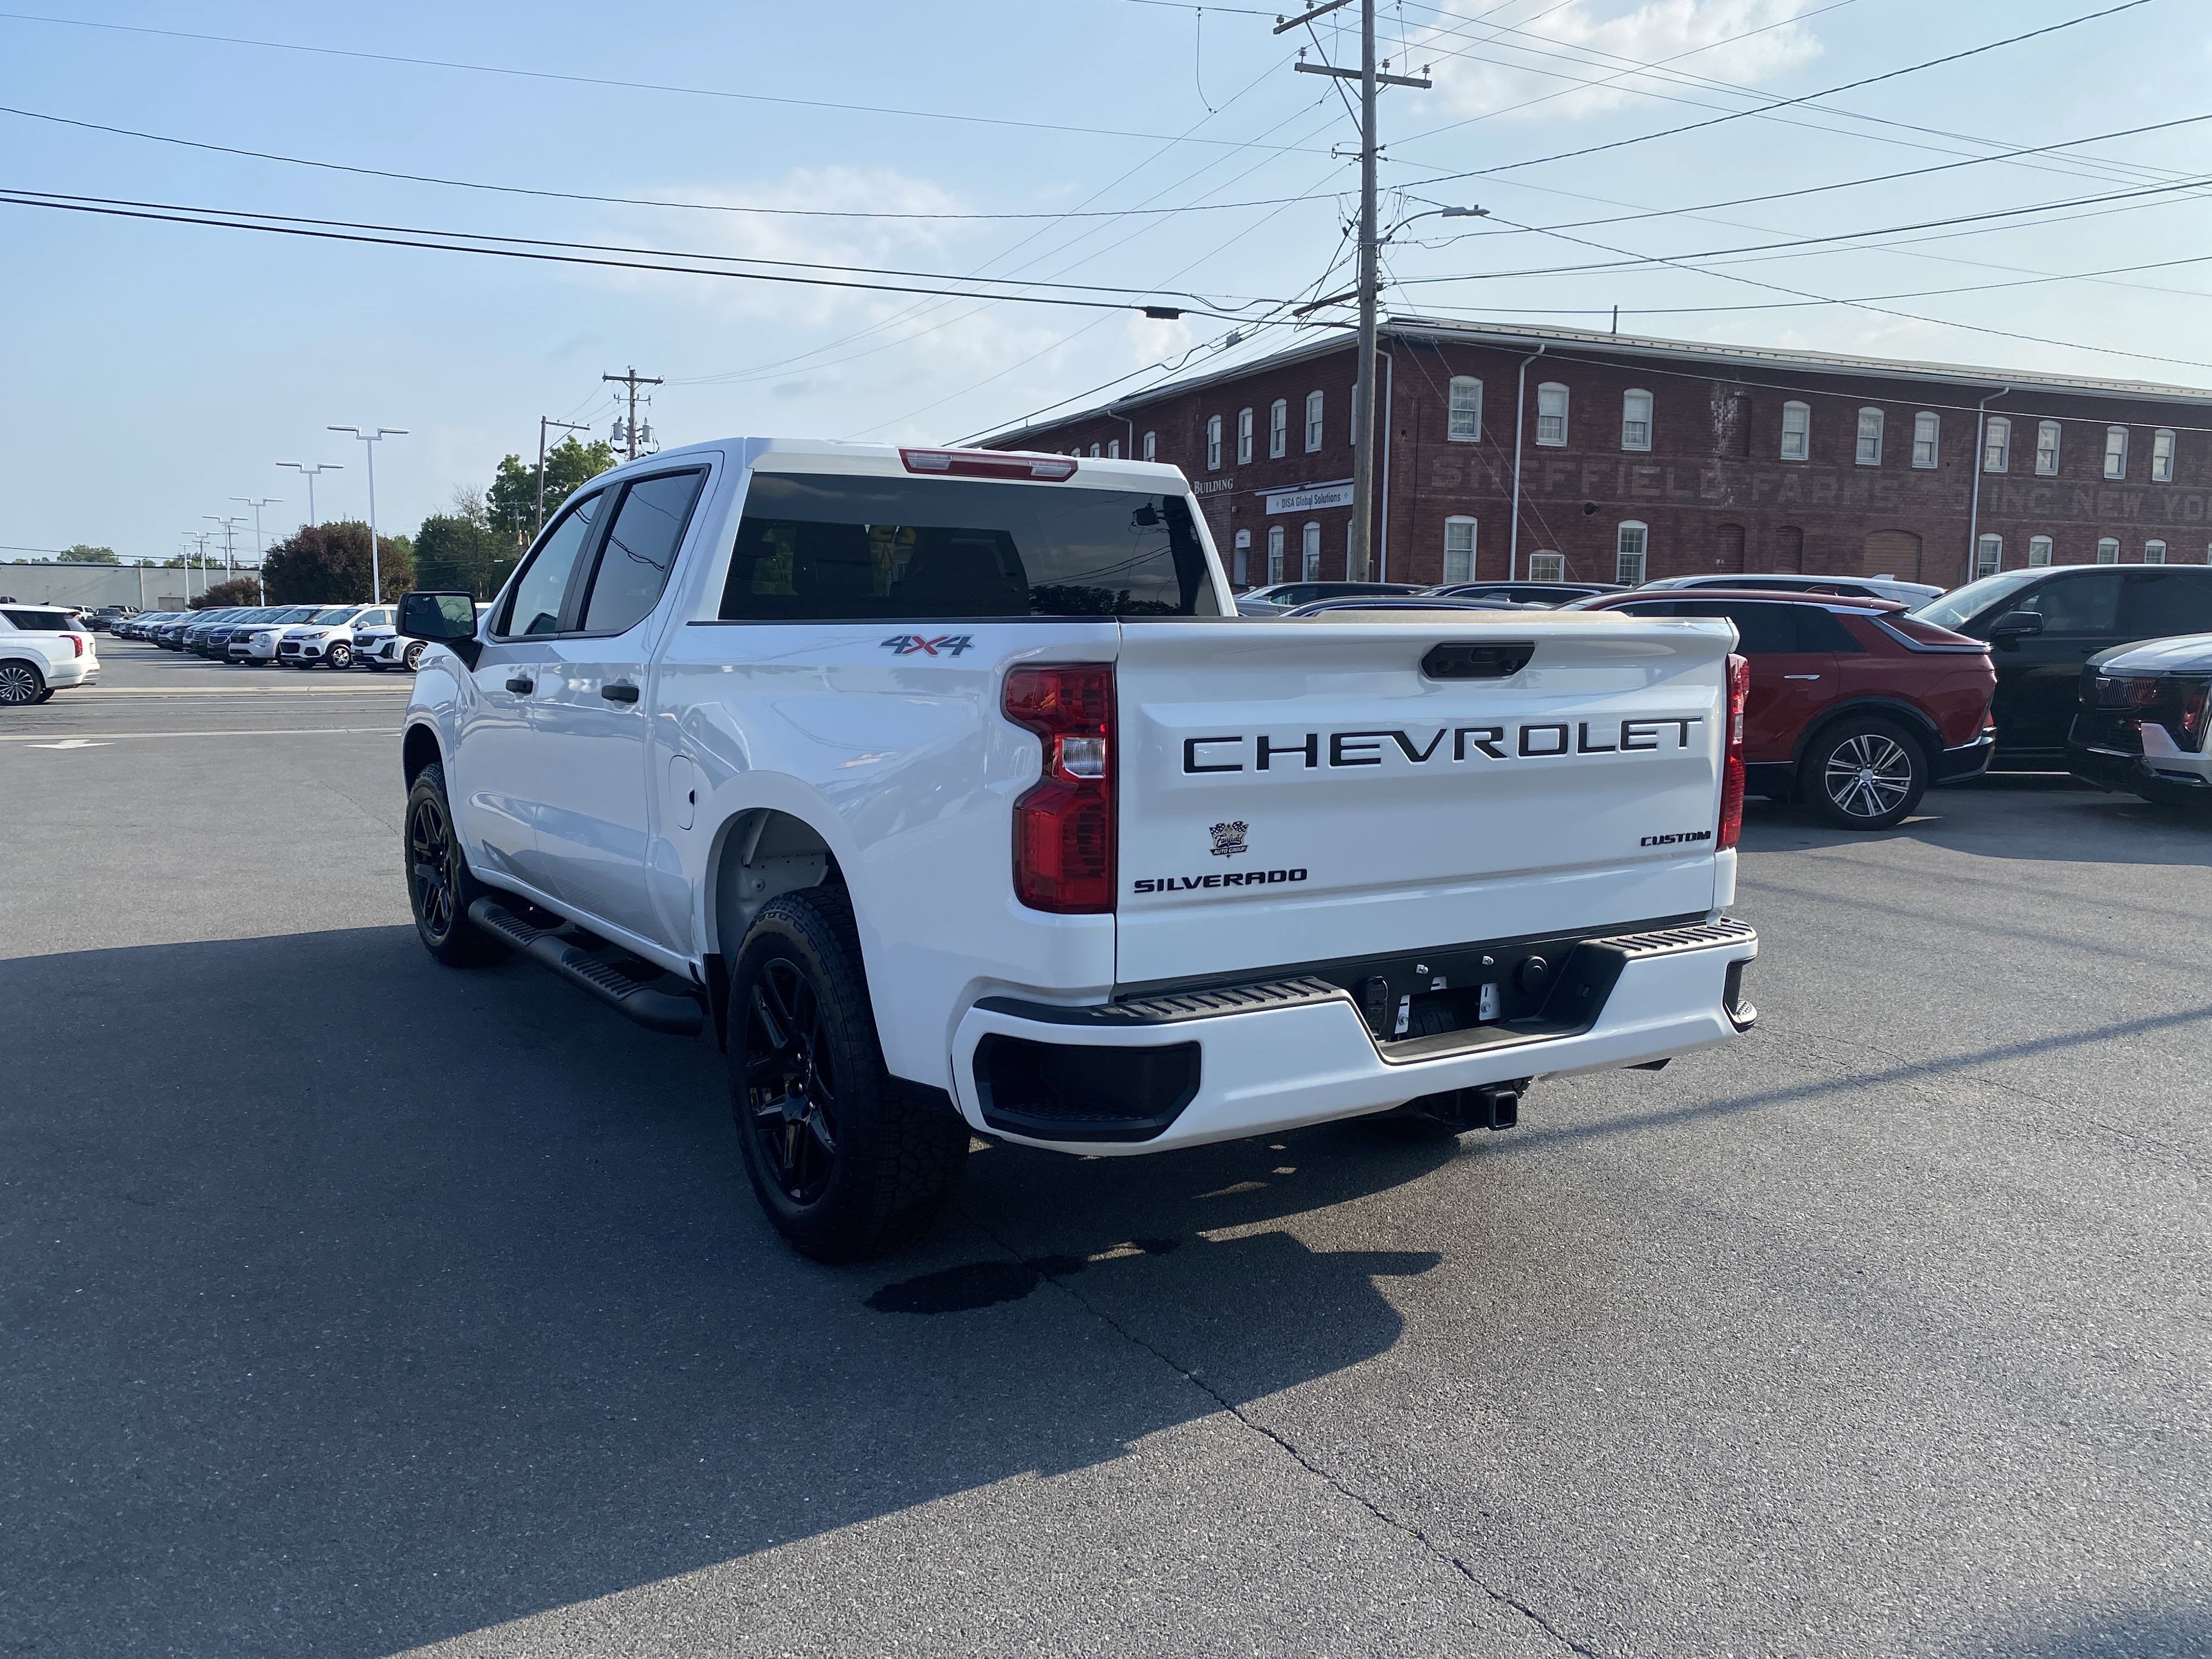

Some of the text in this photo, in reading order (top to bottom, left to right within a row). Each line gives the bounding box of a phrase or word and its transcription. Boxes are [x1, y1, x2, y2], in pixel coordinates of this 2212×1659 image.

[1194, 478, 1234, 494] BUILDING
[1752, 473, 1898, 508] FARMS
[2073, 489, 2143, 518] NEW
[2163, 494, 2212, 520] YO
[1282, 493, 1341, 509] DISA Global Solutions
[1183, 716, 1703, 774] CHEVROLET
[1640, 831, 1712, 847] CUSTOM
[1133, 868, 1308, 894] SILVERADO
